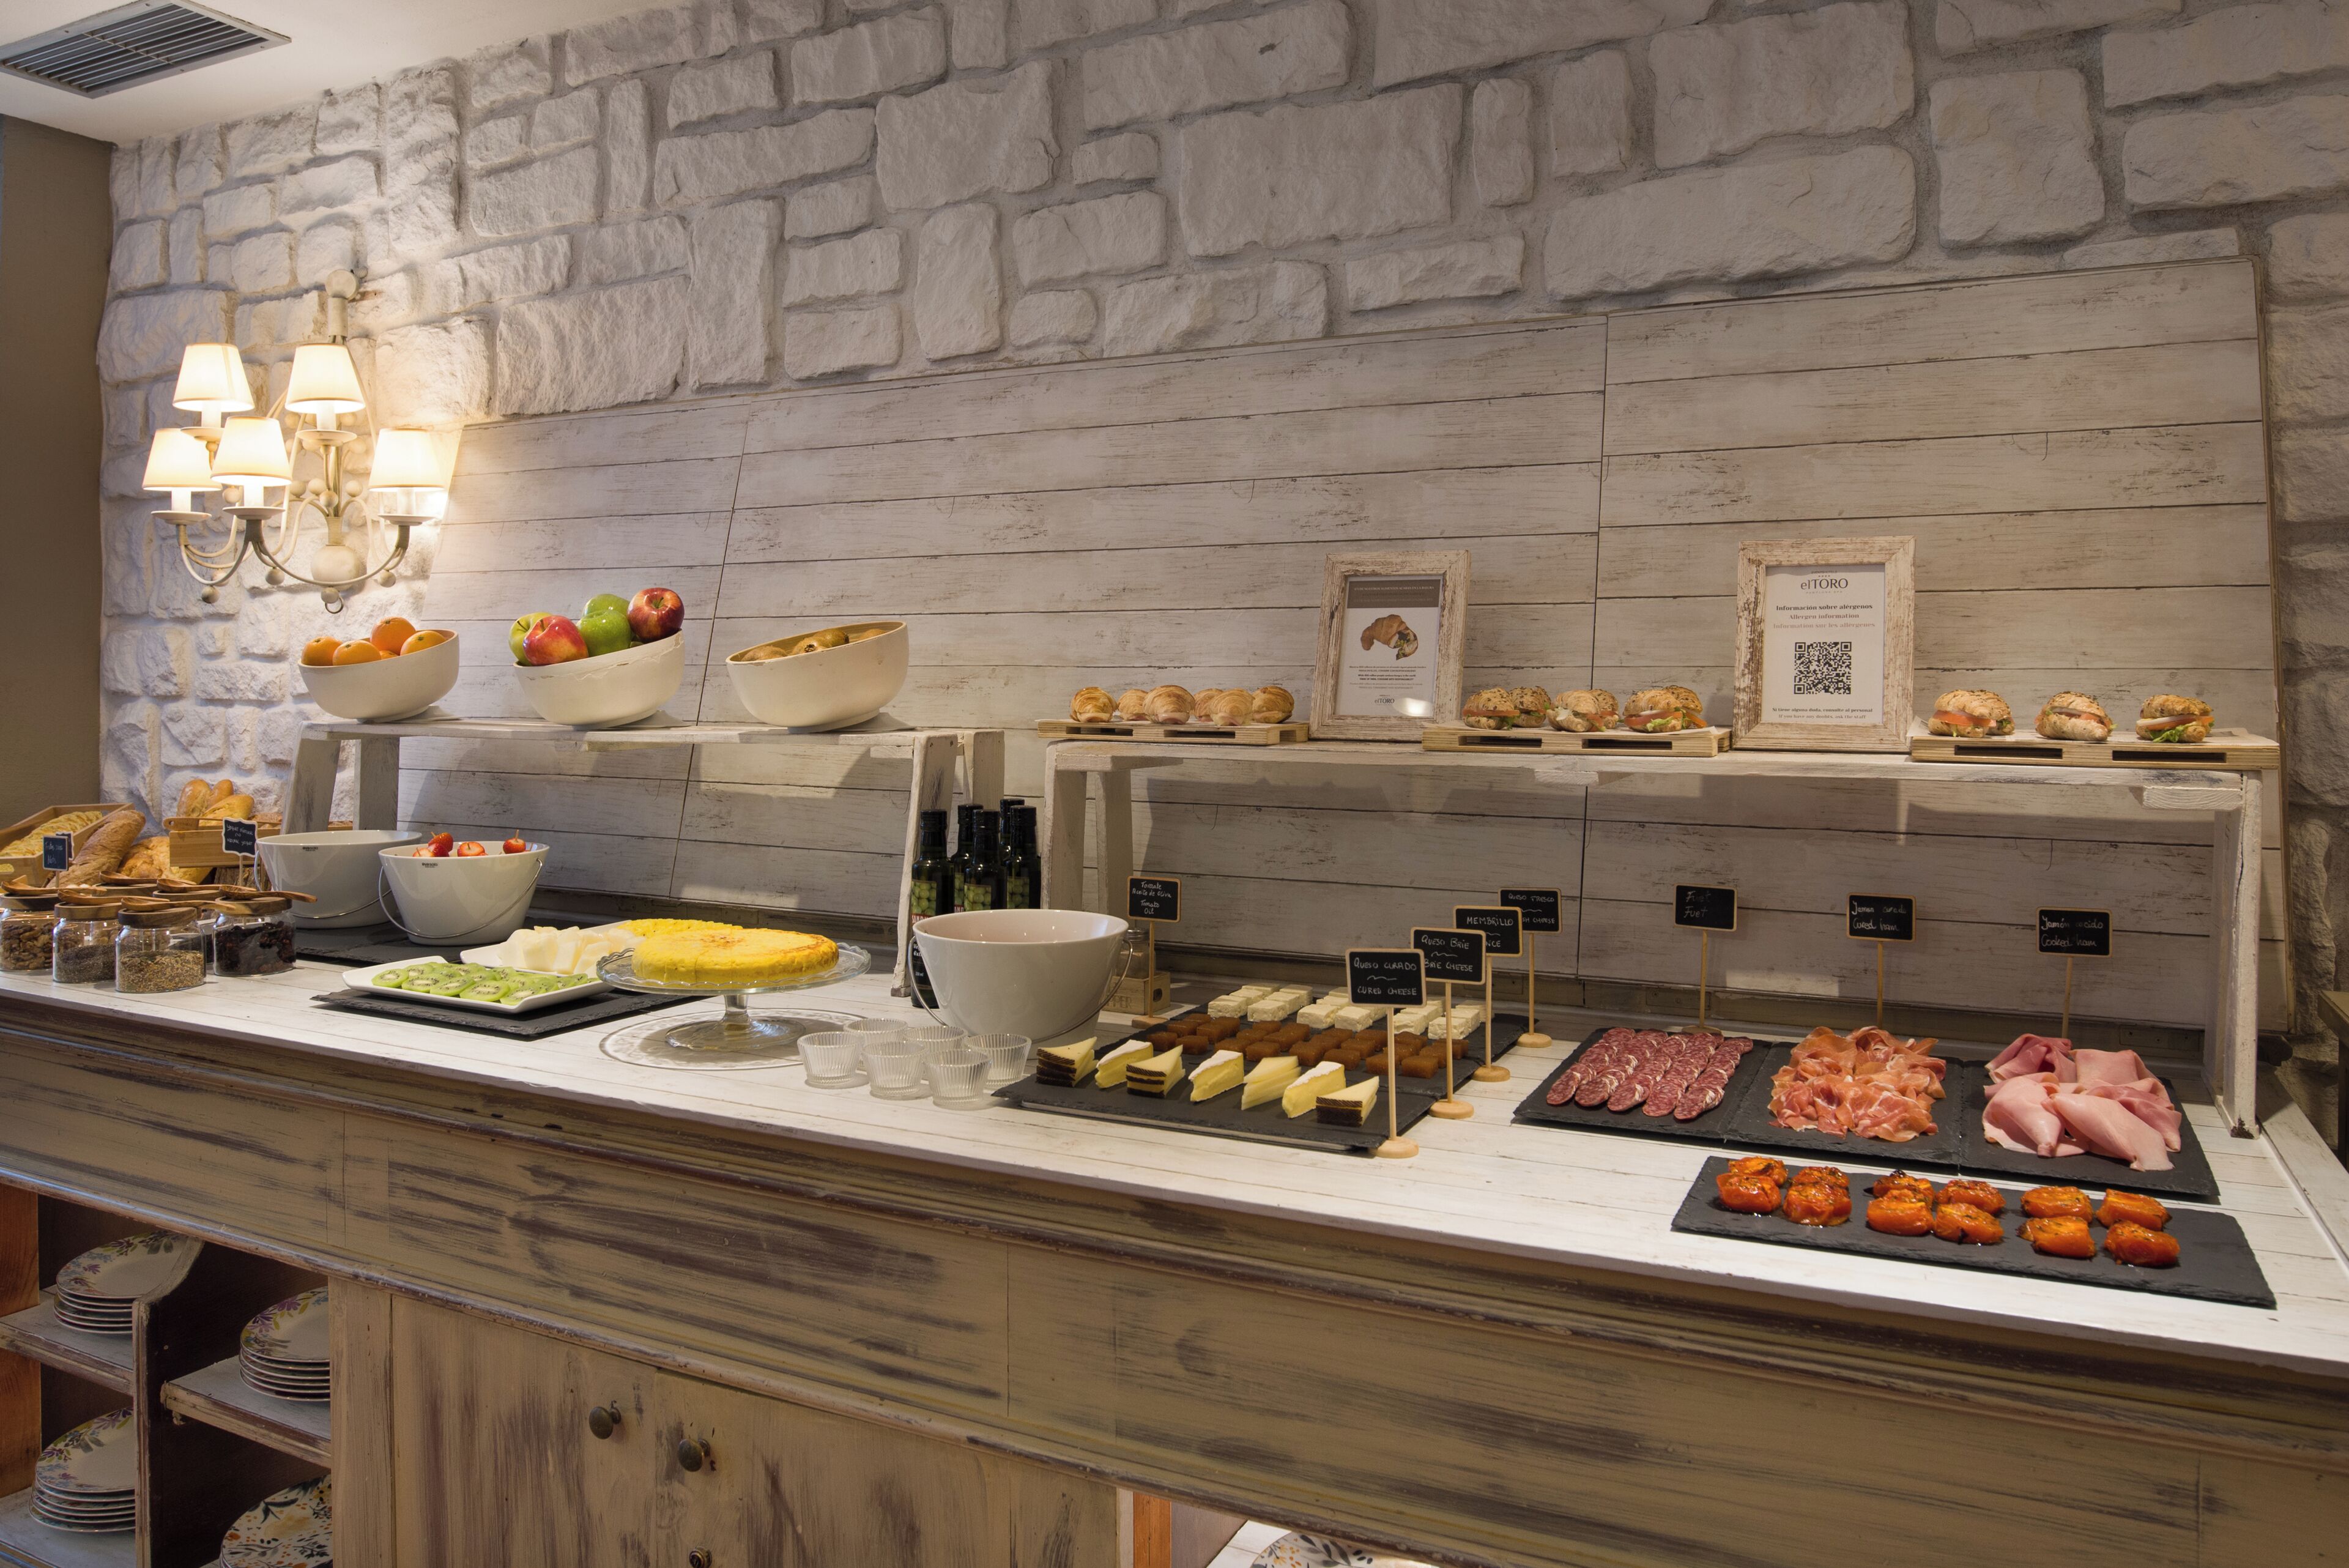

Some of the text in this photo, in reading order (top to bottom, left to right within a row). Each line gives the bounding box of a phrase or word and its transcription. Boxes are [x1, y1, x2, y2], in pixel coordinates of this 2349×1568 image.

[1141, 881, 1162, 890] Tomate
[1141, 899, 1160, 908] Tomato
[1683, 906, 1708, 918] Fuet
[1421, 935, 1445, 946] QUESO
[2041, 934, 2098, 947] Cooked ham
[1354, 957, 1417, 971] QUESO CURADO
[1445, 962, 1474, 972] CHEESE
[1357, 986, 1417, 996] CURED CHEESE
